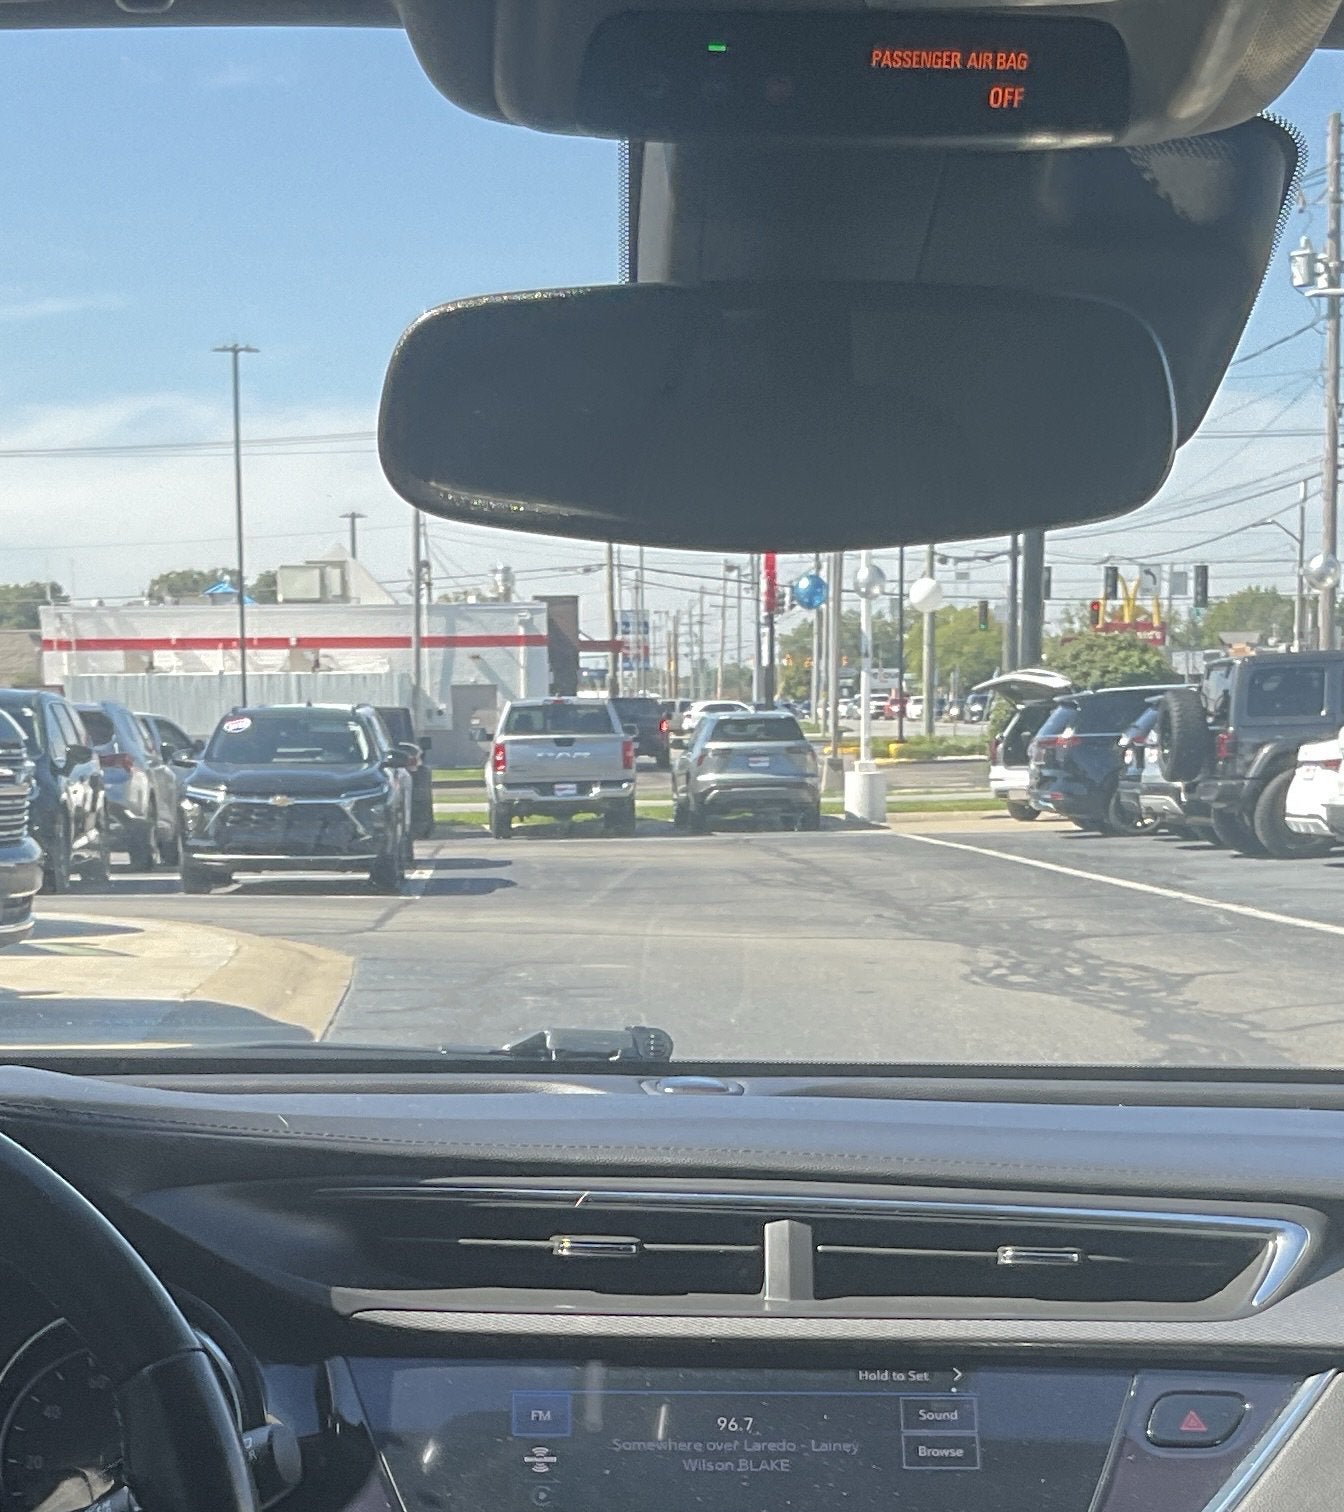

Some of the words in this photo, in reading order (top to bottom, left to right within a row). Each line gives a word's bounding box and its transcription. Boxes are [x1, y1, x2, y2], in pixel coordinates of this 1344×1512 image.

[871, 50, 961, 69] PASSENGER
[967, 52, 993, 70] AIR
[996, 52, 1028, 71] BAG
[989, 86, 1025, 108] OFF
[858, 1370, 888, 1381] Hold
[892, 1371, 905, 1381] to
[908, 1370, 929, 1381] Set
[531, 1410, 552, 1421] FM
[918, 1409, 959, 1421] Sound
[717, 1417, 754, 1432] 96.7
[612, 1438, 703, 1451] Somewhere
[706, 1440, 739, 1451] over
[744, 1440, 796, 1451] Laredo
[811, 1439, 858, 1455] Lainey
[918, 1446, 964, 1457] Browse
[683, 1458, 734, 1471] Wilson
[737, 1459, 791, 1472] BLAKE
